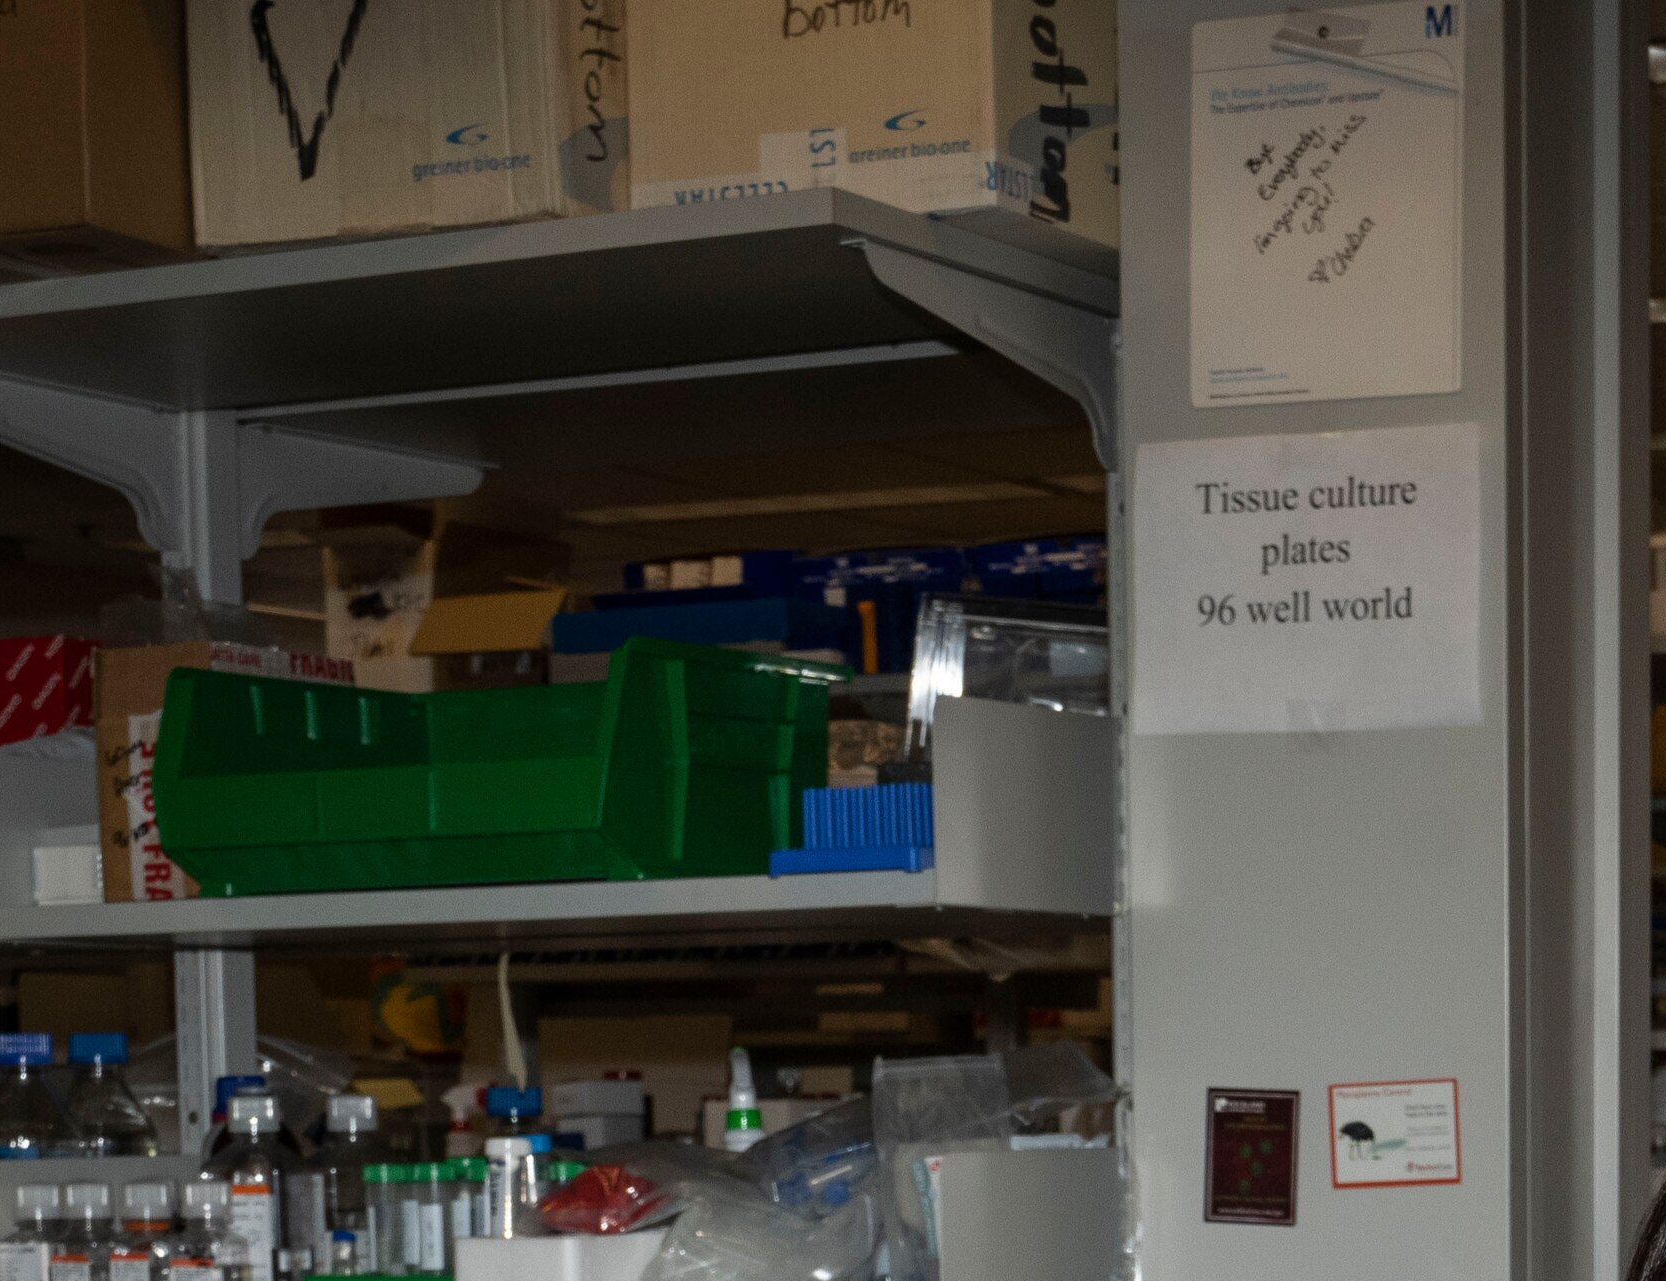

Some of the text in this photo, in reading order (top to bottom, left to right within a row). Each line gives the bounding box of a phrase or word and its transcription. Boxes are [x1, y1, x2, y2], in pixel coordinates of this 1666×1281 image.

[1195, 476, 1418, 515] Tissue culture
[1260, 534, 1351, 575] plates
[1196, 586, 1414, 627] 96 well world
